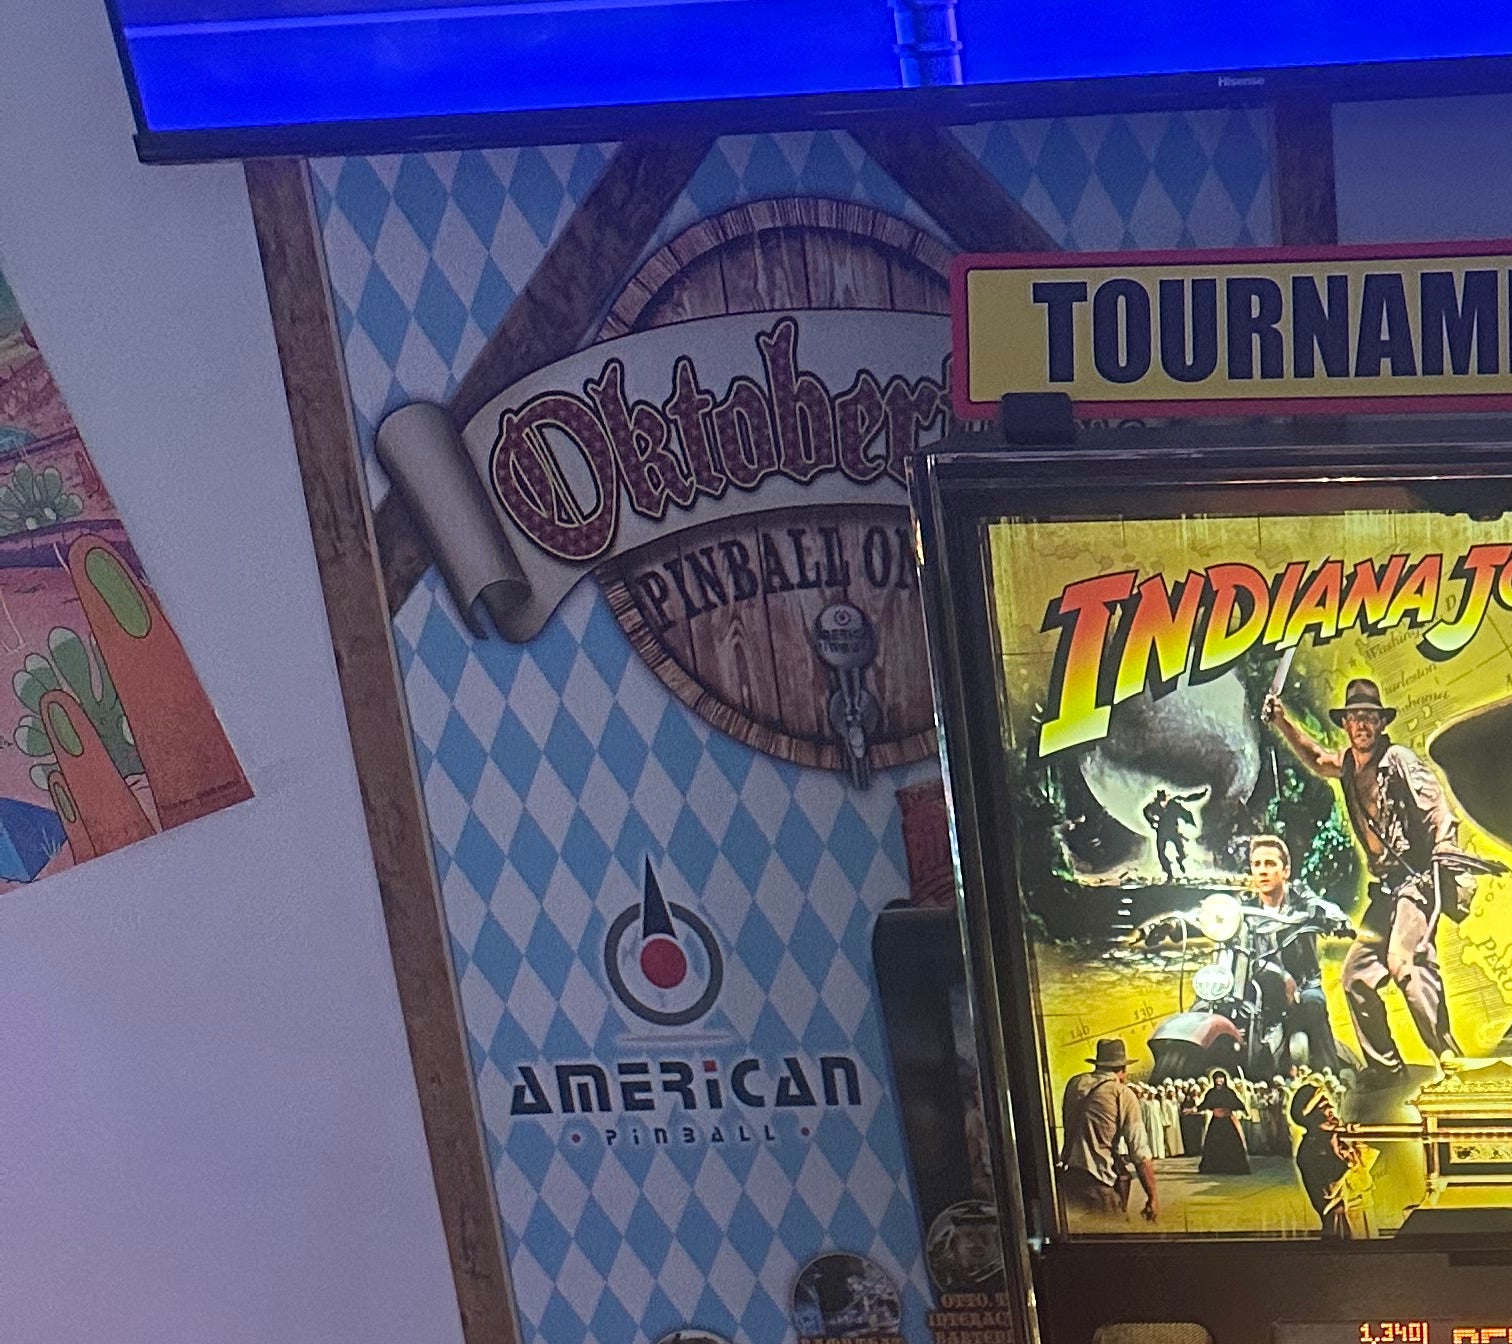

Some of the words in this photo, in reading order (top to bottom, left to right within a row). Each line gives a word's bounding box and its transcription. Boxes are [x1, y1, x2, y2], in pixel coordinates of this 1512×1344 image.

[491, 316, 951, 560] Oktober
[637, 527, 851, 632] PINBALL
[1038, 552, 1443, 758] INDIANA
[605, 1124, 776, 1146] PINBALL
[929, 1311, 1012, 1327] INTERAC
